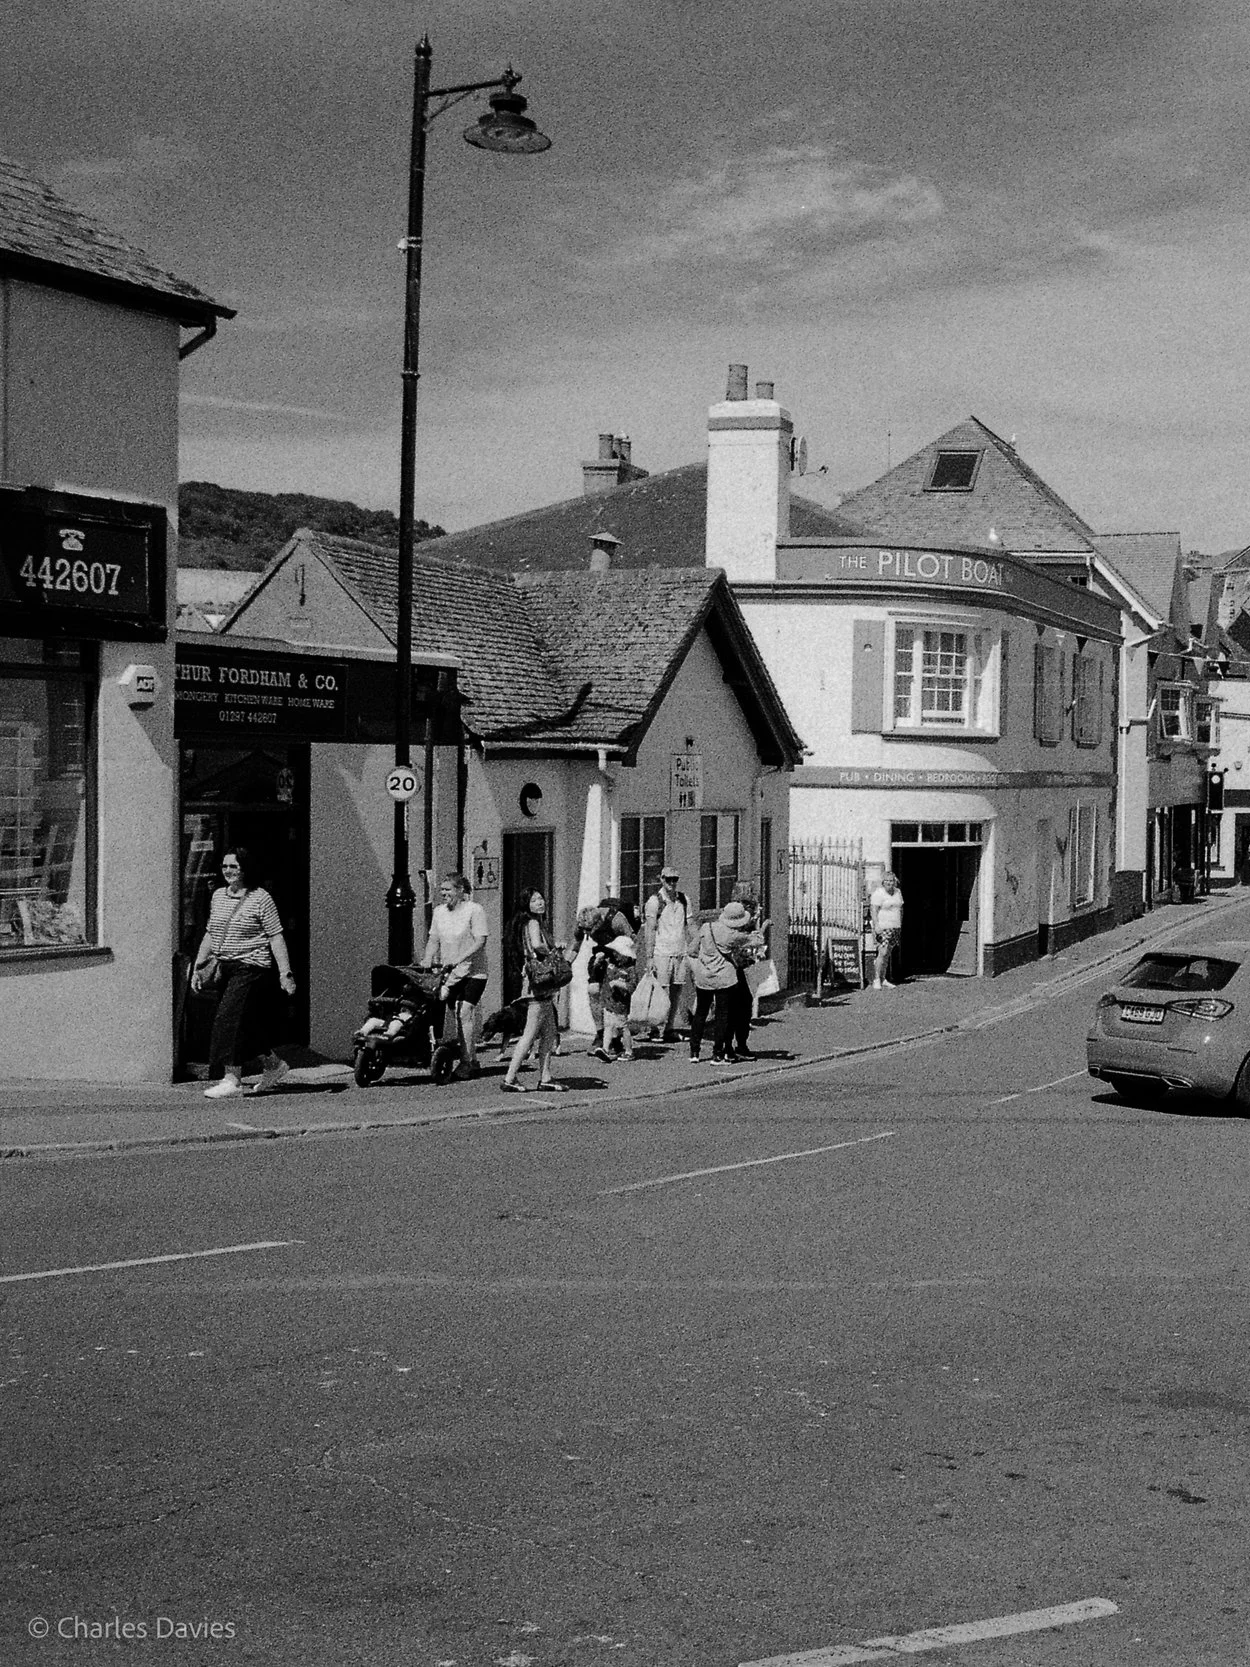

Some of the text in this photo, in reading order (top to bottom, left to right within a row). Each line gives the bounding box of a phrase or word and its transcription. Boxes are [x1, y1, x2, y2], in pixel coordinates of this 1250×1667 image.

[19, 555, 122, 596] 442607
[839, 551, 1004, 586] THE PILOT BOAT
[219, 667, 292, 688] FORDHAM
[298, 673, 308, 689] &
[315, 675, 339, 691] CO.
[247, 712, 277, 724] 442607
[390, 776, 415, 791] 20
[839, 772, 860, 782] PUB
[873, 772, 915, 783] DINING
